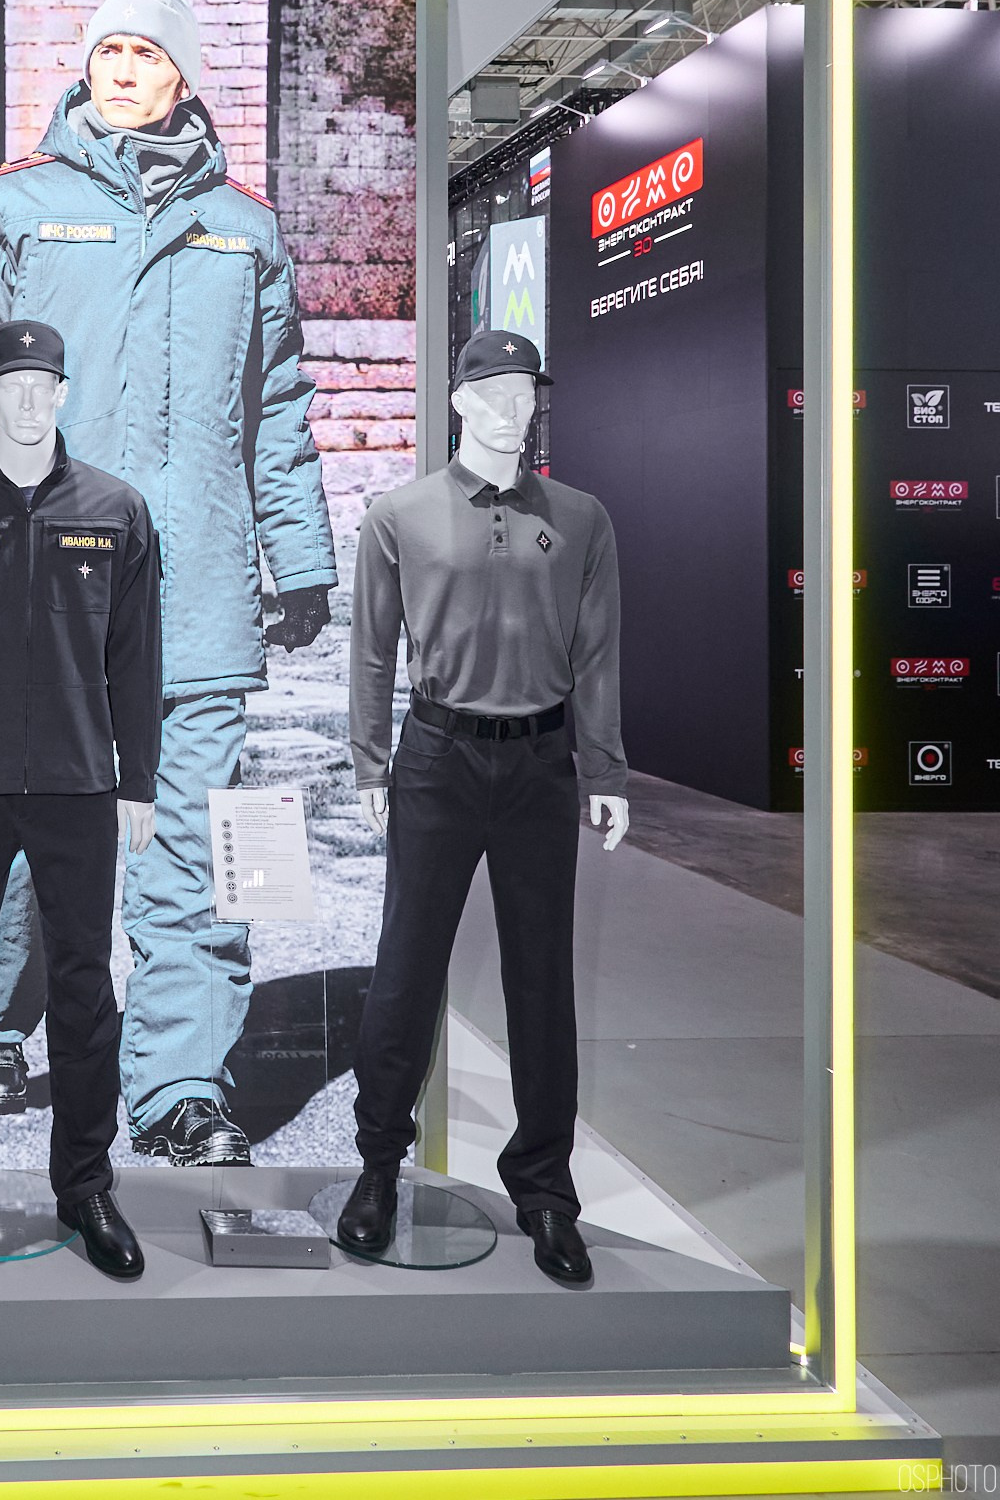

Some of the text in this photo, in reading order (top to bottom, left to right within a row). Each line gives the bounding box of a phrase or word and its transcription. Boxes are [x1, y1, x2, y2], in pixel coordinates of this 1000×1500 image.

[40, 224, 112, 240] МЧС РОССИИ
[597, 197, 694, 253] ЭНЕРГОКОНТРАКТ
[185, 232, 250, 250] ИВАНОВ И.И.
[633, 235, 653, 257] 30
[590, 259, 704, 318] БЕРЕГИТЕ СЕБЯ!
[913, 406, 937, 415] БИО
[913, 414, 943, 424] СТОП
[61, 536, 113, 549] ИВАНОВ И.И.
[911, 589, 948, 597] ЭНЕРГО
